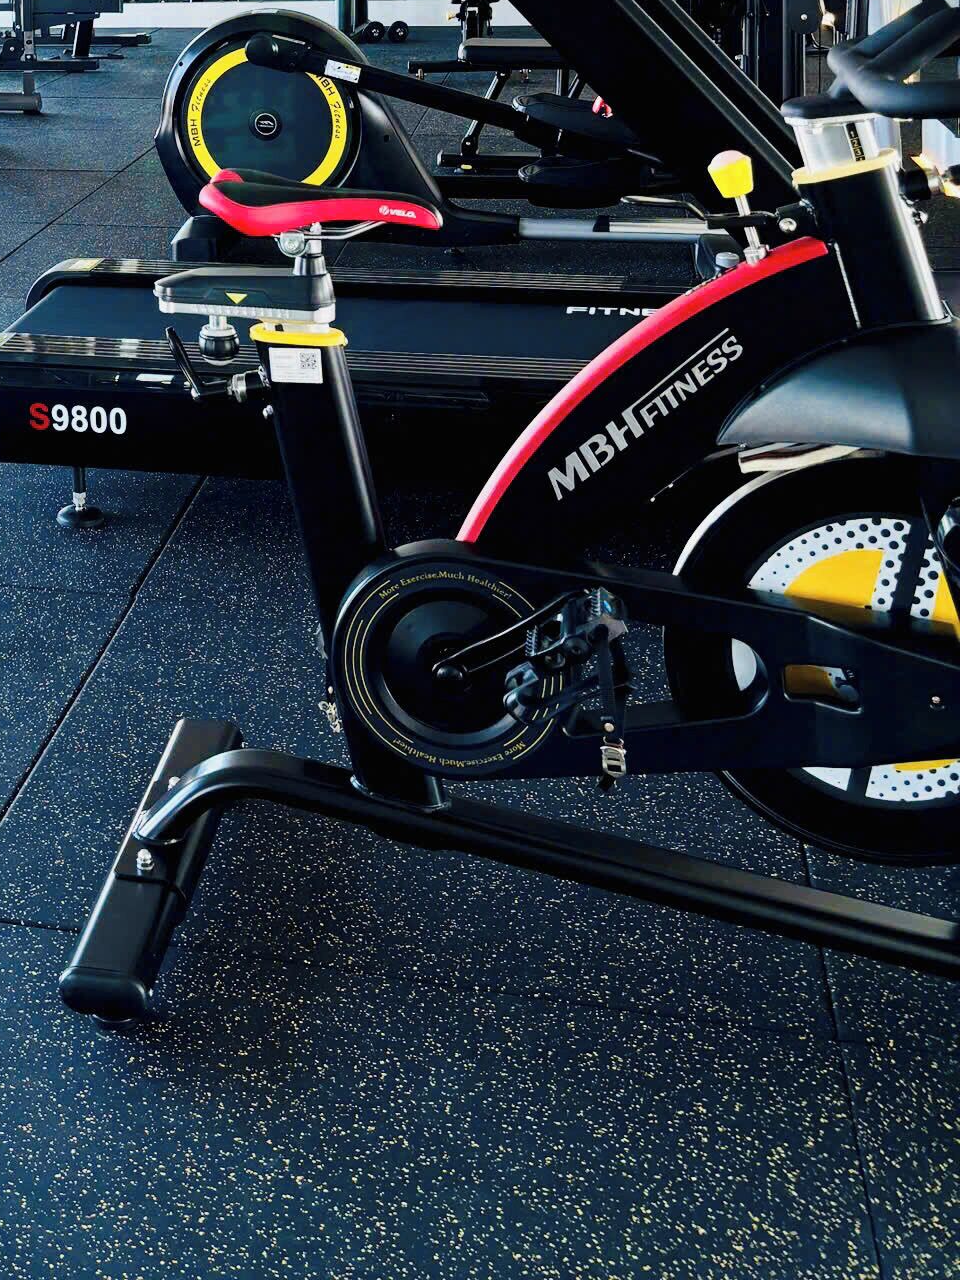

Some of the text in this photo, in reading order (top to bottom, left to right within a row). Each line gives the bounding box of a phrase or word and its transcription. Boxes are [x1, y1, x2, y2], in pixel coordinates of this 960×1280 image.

[190, 119, 201, 147] MBH
[330, 100, 342, 139] Fitness
[565, 306, 658, 317] FITNE
[640, 335, 743, 428] FITNESS
[29, 402, 128, 435] S9800
[378, 584, 400, 600] More
[504, 740, 527, 757] More
